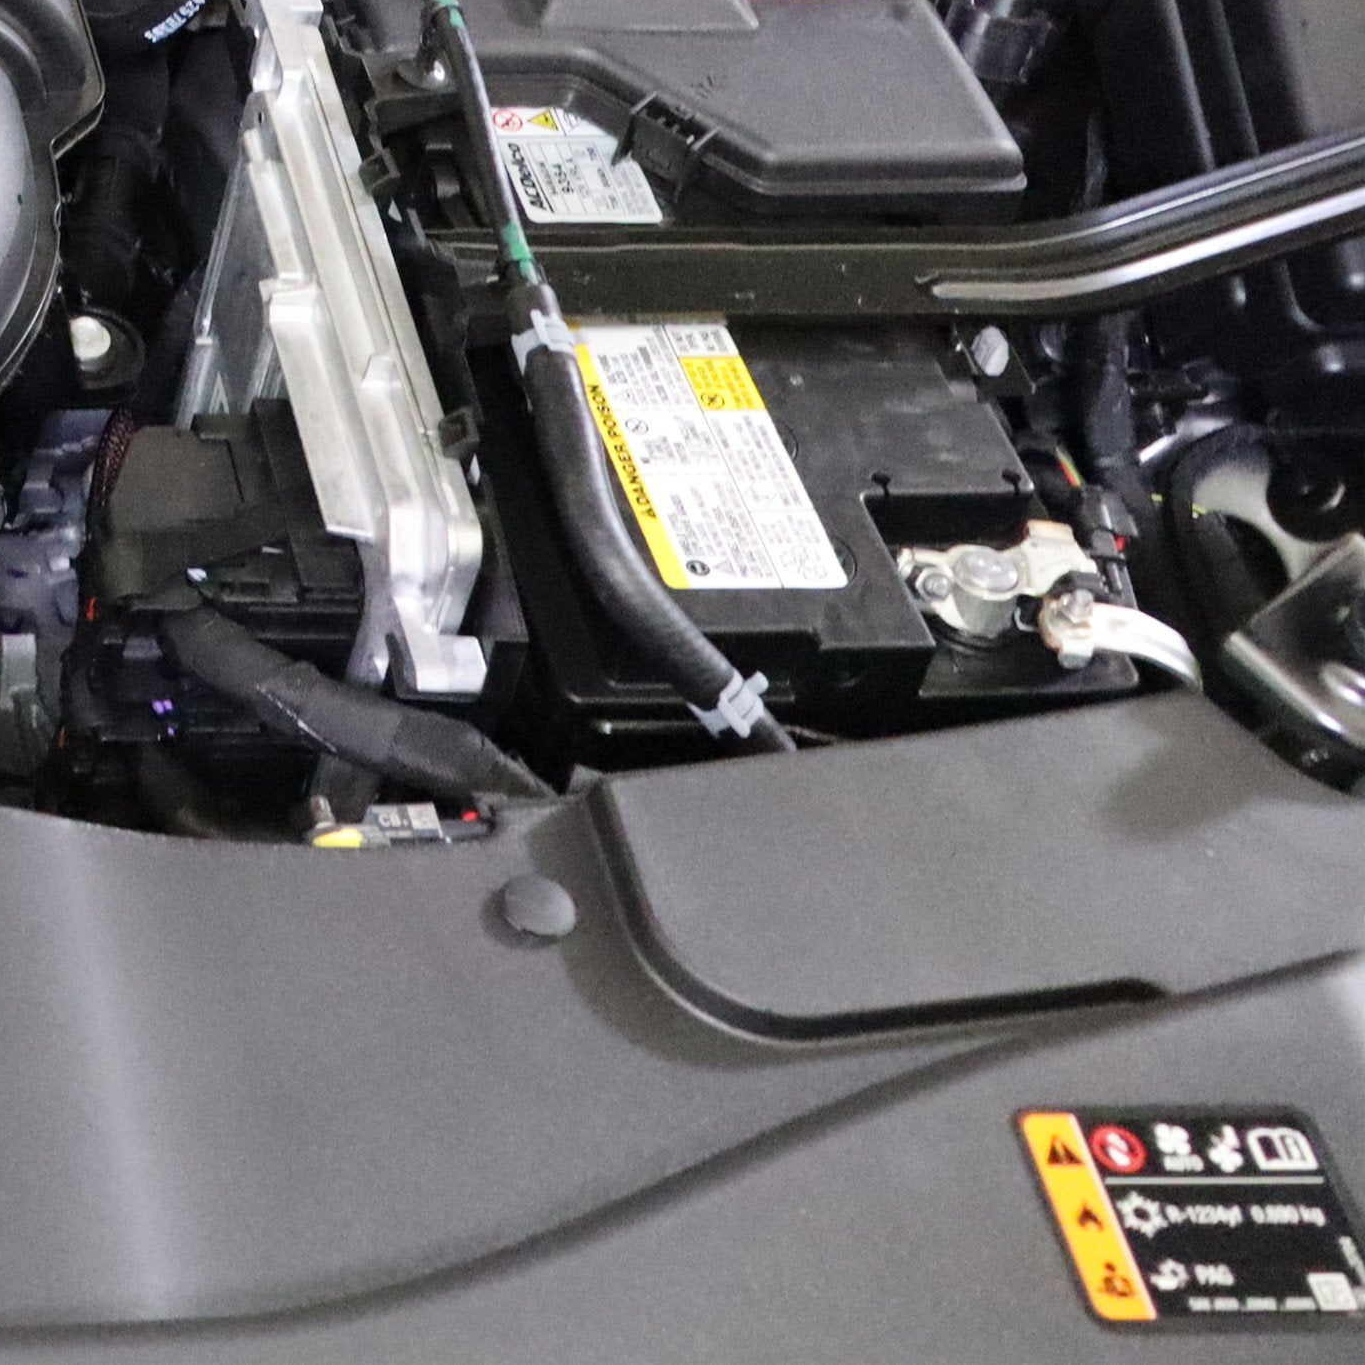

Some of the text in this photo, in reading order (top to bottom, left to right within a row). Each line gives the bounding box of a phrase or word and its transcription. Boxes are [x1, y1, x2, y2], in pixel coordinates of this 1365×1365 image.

[507, 142, 548, 211] ACDelco
[587, 384, 621, 439] POISON
[614, 443, 651, 507] DANGER
